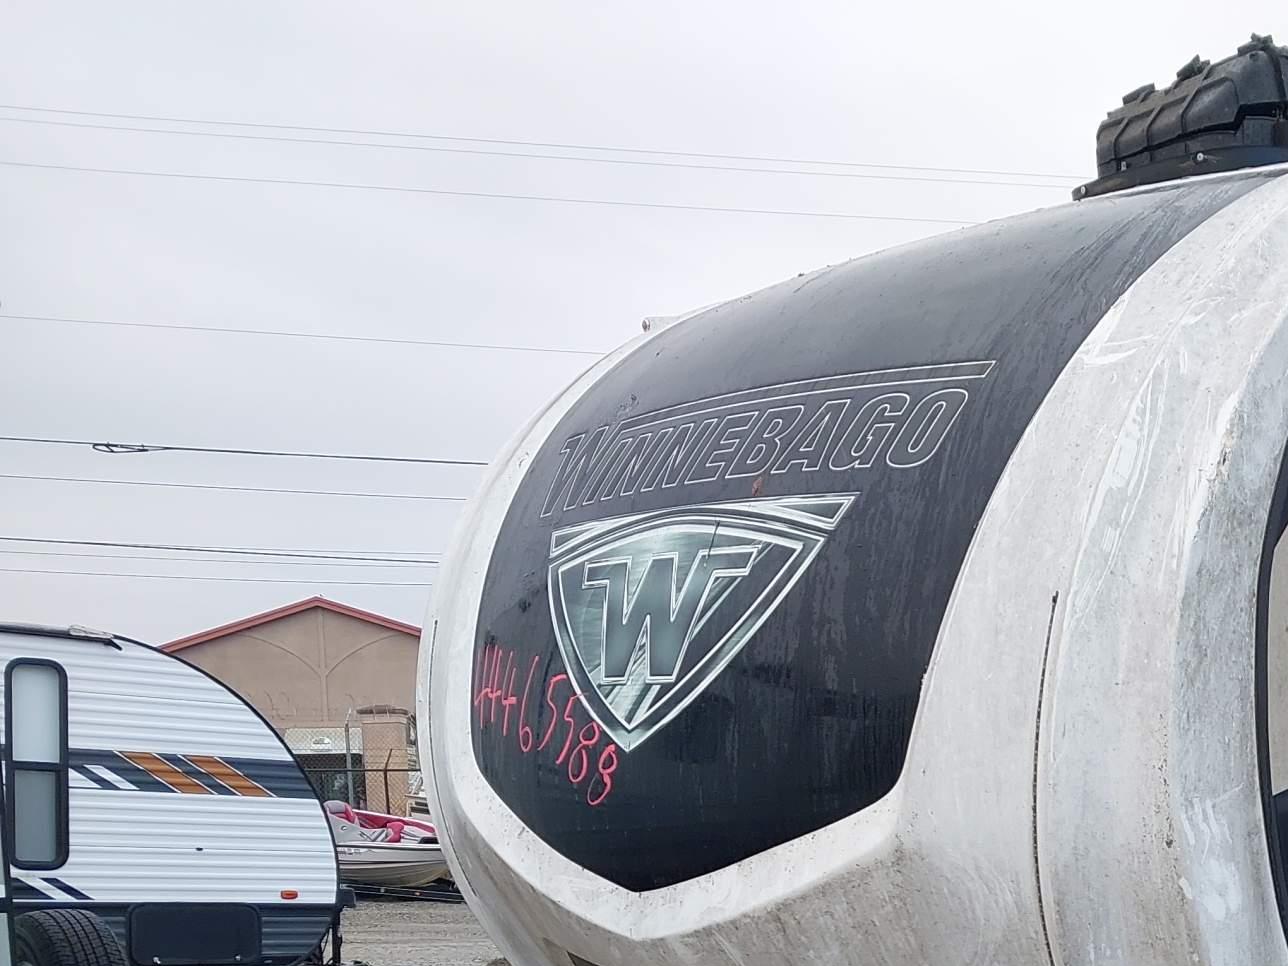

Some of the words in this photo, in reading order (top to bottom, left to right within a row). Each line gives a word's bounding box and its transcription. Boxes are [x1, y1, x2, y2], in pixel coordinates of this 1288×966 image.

[540, 388, 969, 518] WINNEBAGO
[581, 544, 762, 685] W
[473, 644, 618, 806] 44465588
